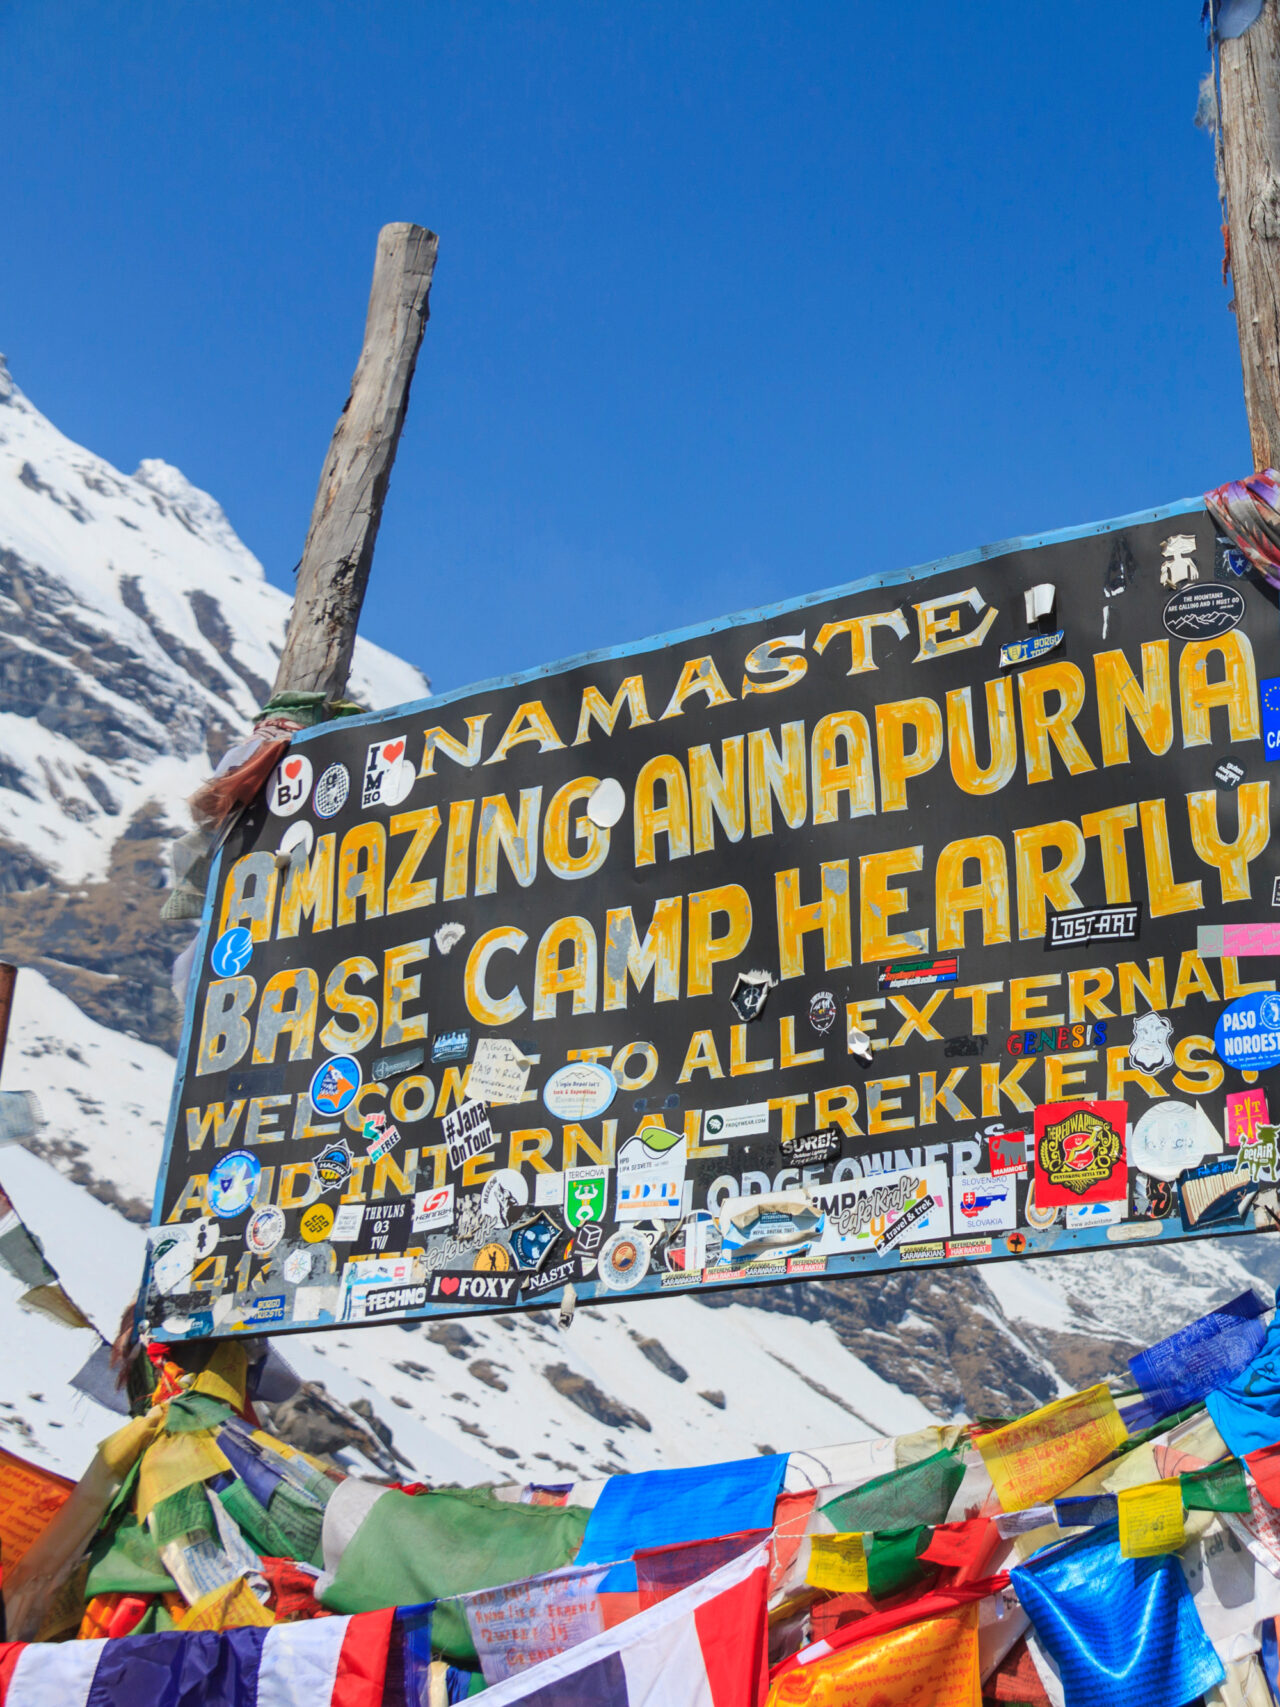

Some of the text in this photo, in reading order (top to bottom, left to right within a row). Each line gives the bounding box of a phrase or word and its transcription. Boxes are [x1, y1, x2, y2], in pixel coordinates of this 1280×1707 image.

[1193, 592, 1224, 602] MOUNTAINS
[415, 586, 999, 780] NAMASTE
[367, 745, 381, 772] I
[634, 629, 1261, 868] ANNAPURNA
[278, 778, 303, 807] BJ
[217, 776, 612, 944] AMAZING
[775, 781, 1271, 979] HEARTLY
[464, 884, 751, 1026] CAMP
[196, 938, 430, 1076] BASE
[677, 1015, 825, 1084] ALL
[846, 949, 1277, 1056] EXTERNAL
[1223, 1010, 1257, 1032] PASO
[1006, 1021, 1108, 1056] GENESIS
[446, 1102, 488, 1144] #Jana
[380, 1131, 400, 1154] FREE
[319, 1162, 346, 1175] MACAW
[993, 1163, 1027, 1176] MAMMOET
[962, 1175, 1007, 1187] SLOVENSKO
[872, 1175, 920, 1218] Kraft
[364, 1203, 406, 1221] THRVLNS
[886, 1216, 908, 1242] travel
[907, 1211, 916, 1221] &
[915, 1197, 933, 1218] trek
[967, 1217, 1003, 1228] SLOVAKIA
[373, 1220, 390, 1234] 03
[901, 1249, 946, 1261] SARAWAKIANS
[950, 1240, 987, 1249] REFERENDUM
[963, 1245, 987, 1254] RAKYAT
[792, 1257, 827, 1266] REFERENDUM
[802, 1263, 826, 1271] RAKYAT
[529, 1259, 576, 1291] NASTY
[431, 1276, 442, 1296] I
[457, 1276, 516, 1299] FOXY
[257, 1298, 281, 1309] BORGO
[367, 1286, 427, 1313] TECHNO
